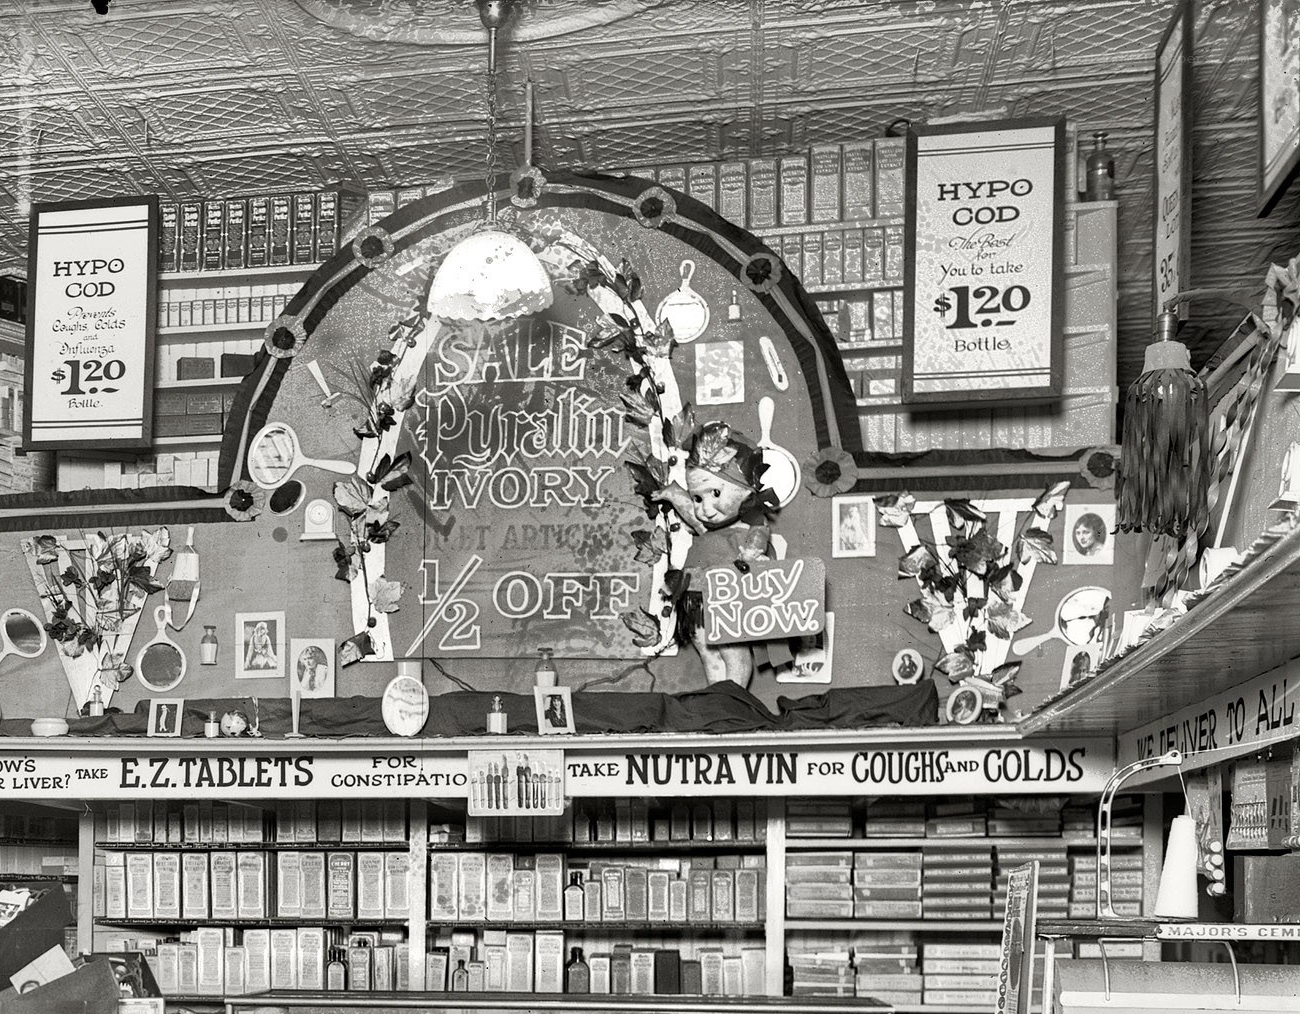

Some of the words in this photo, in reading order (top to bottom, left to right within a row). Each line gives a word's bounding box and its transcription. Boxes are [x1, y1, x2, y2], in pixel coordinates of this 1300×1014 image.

[937, 179, 1033, 201] HYPO
[952, 205, 1021, 226] COD
[949, 227, 984, 250] The
[978, 233, 1016, 249] Best
[976, 247, 997, 261] for
[53, 258, 125, 277] HYPO
[971, 263, 983, 276] to
[990, 261, 1023, 275] take
[65, 281, 116, 298] COD
[67, 306, 116, 320] Prevents
[933, 285, 1031, 329] $1.20
[94, 319, 126, 330] Colds
[58, 341, 115, 358] Influenza
[435, 321, 588, 386] SALE
[51, 359, 126, 395] $1.20
[416, 385, 631, 473] Pyralin
[430, 467, 614, 510] IVORY
[493, 571, 640, 620] OFF
[1137, 733, 1154, 772] WE
[1159, 708, 1218, 767] DELIVER
[1226, 697, 1246, 745] TO
[1255, 679, 1295, 736] ALL
[372, 756, 416, 769] FOR
[567, 763, 620, 778] TAKE
[625, 753, 736, 785] NUTRA
[742, 753, 799, 784] VIN
[807, 762, 846, 776] FOR
[851, 751, 949, 784] COUGHS
[945, 760, 980, 774] AND
[983, 747, 1087, 783] COLDS
[12, 773, 72, 791] LIVER?
[75, 768, 109, 781] TAKE
[331, 772, 468, 788] CONSTIPATIO
[1167, 926, 1248, 937] MAJOR'S
